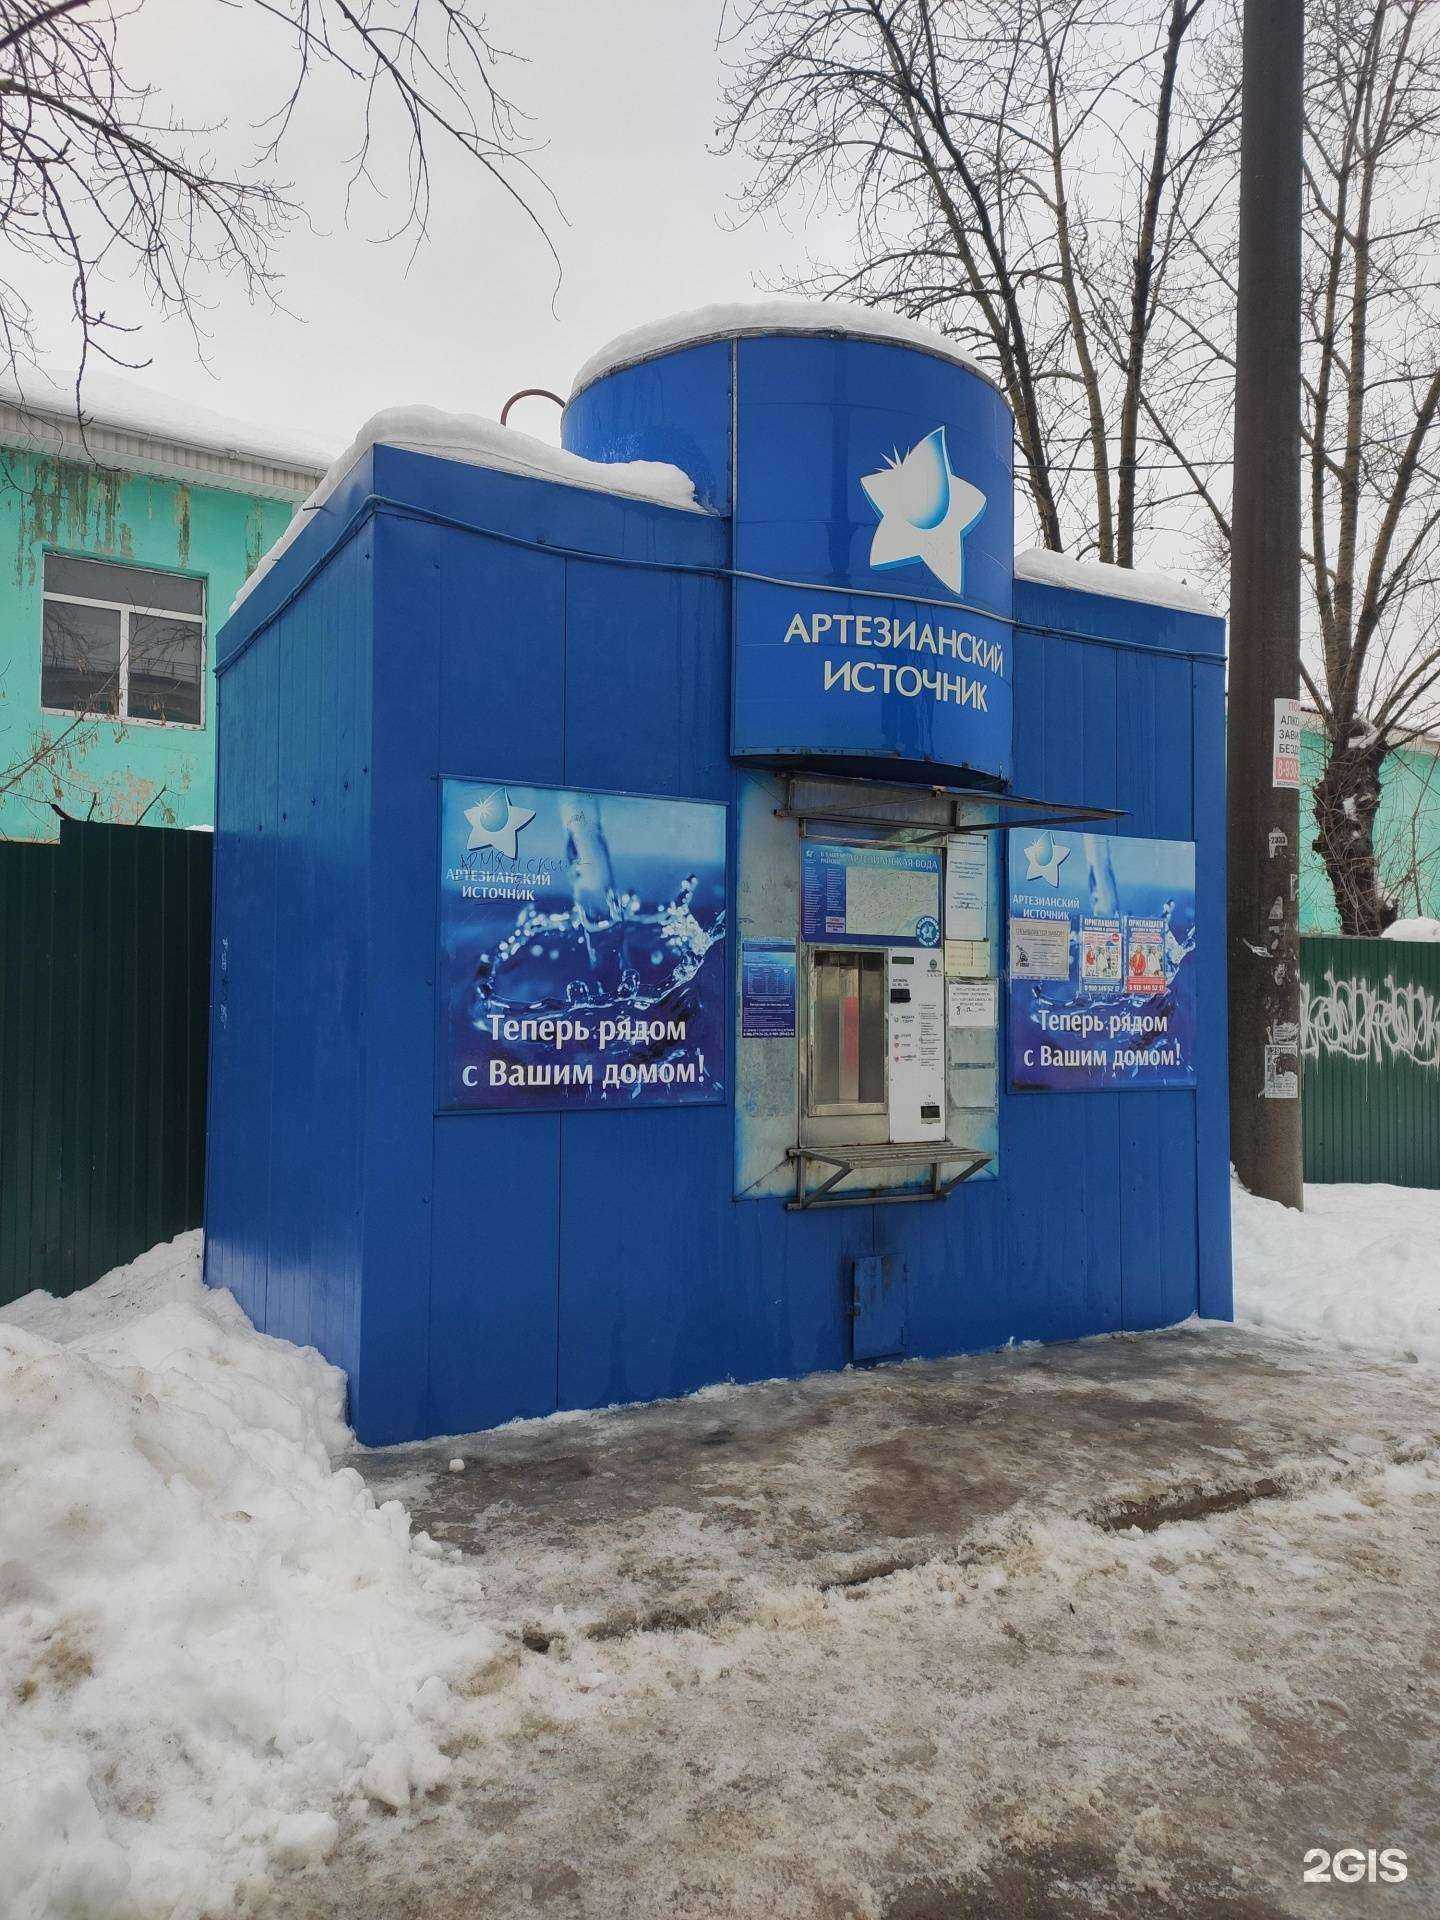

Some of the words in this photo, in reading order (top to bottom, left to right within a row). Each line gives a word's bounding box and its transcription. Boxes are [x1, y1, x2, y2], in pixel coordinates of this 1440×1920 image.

[783, 612, 1004, 678] АРТЕЗИАНСКИЙ
[823, 660, 988, 713] ИСТОЧНИК
[446, 868, 551, 886] АРТЕЗИАНСКИЙ
[915, 858, 938, 871] ВОДА
[462, 885, 535, 901] ИСТОЧНИК
[1012, 894, 1080, 909] АРТЕЗИАНСКИЙ
[1023, 908, 1070, 921] ИСТОЧНИК
[486, 1013, 590, 1050] Теперь
[599, 1019, 686, 1050] рядом
[1038, 1009, 1104, 1039] Теперь
[1109, 1014, 1168, 1039] рядом
[1023, 1049, 1034, 1067] с
[1040, 1045, 1107, 1067] Вашим
[1112, 1043, 1181, 1070] домом!
[462, 1065, 478, 1087] с
[488, 1059, 593, 1087] Вашим
[602, 1055, 705, 1090] домом!
